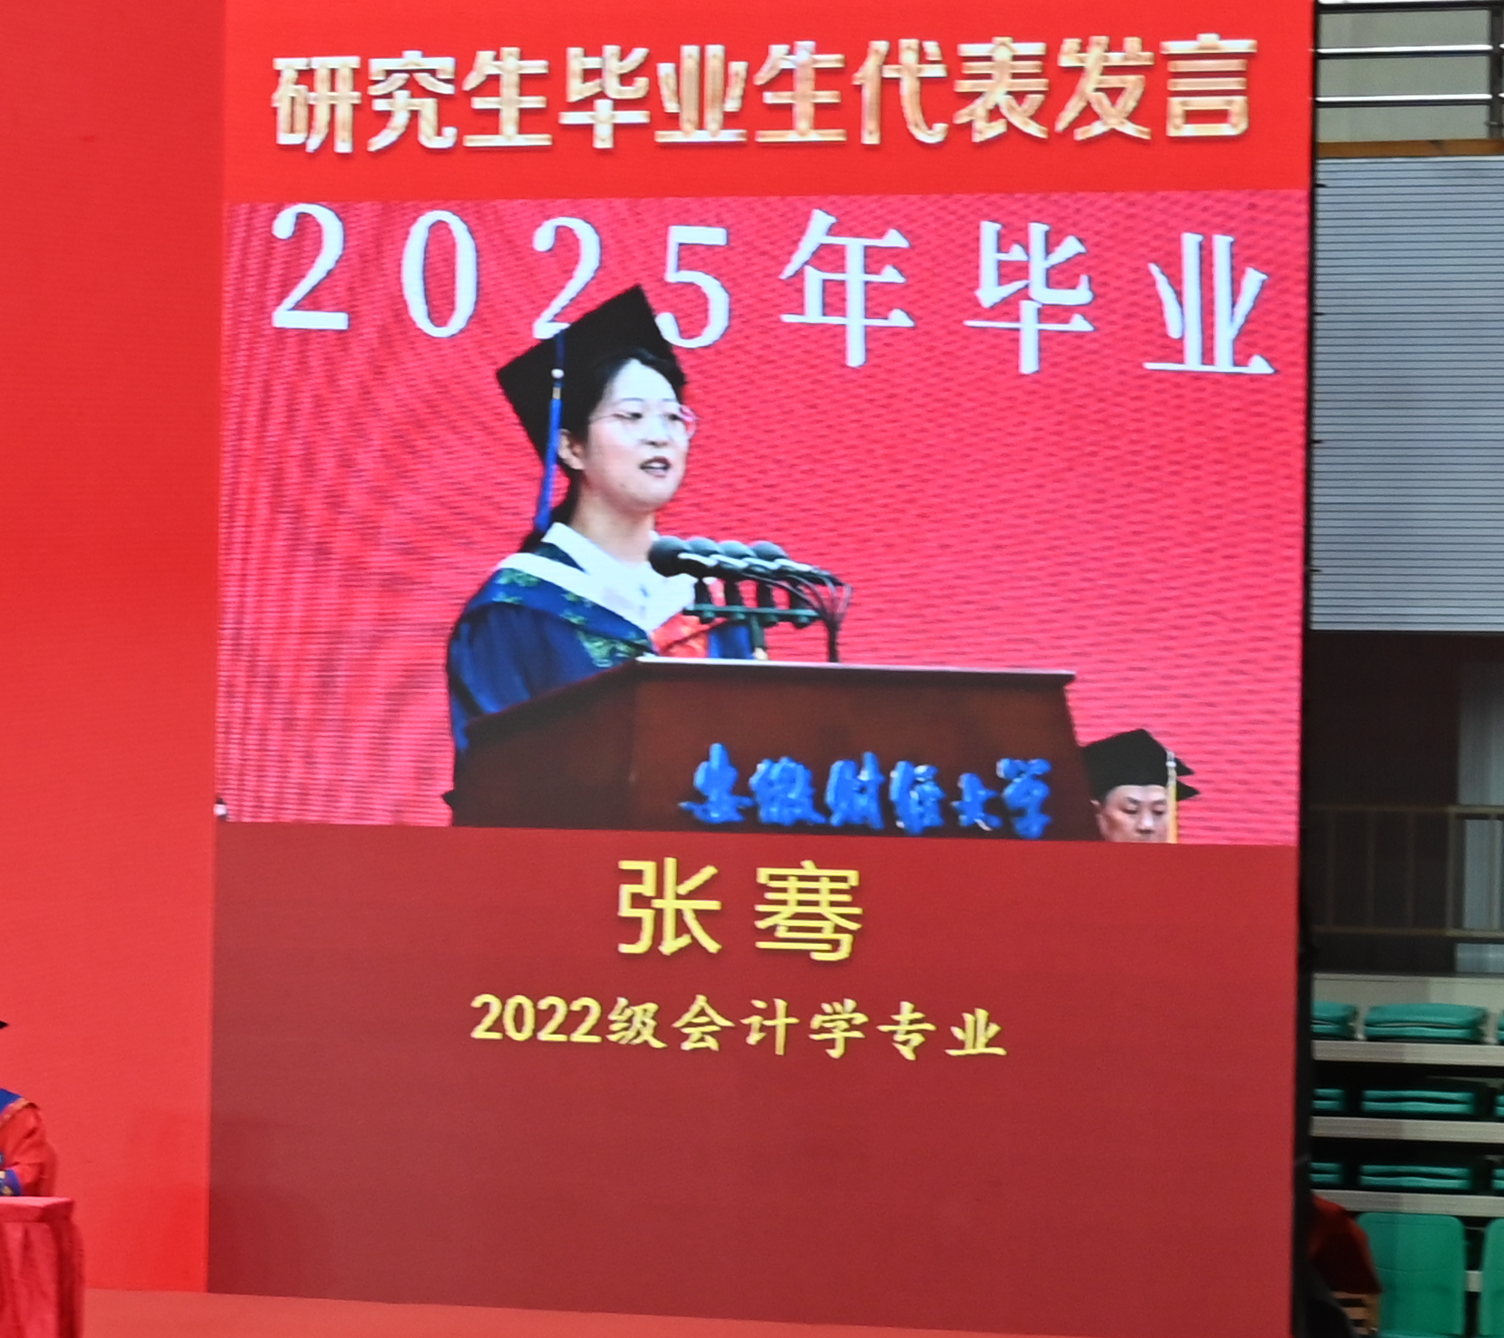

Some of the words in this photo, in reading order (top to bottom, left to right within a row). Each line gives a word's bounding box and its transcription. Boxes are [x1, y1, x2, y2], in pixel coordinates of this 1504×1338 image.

[270, 31, 1258, 154] 研究生毕业生代表发言
[270, 201, 1276, 378] 2025年毕业
[680, 742, 1052, 835] 安徽财经大学
[617, 856, 864, 962] 张骞
[470, 993, 1007, 1061] 2022级会计学专业
